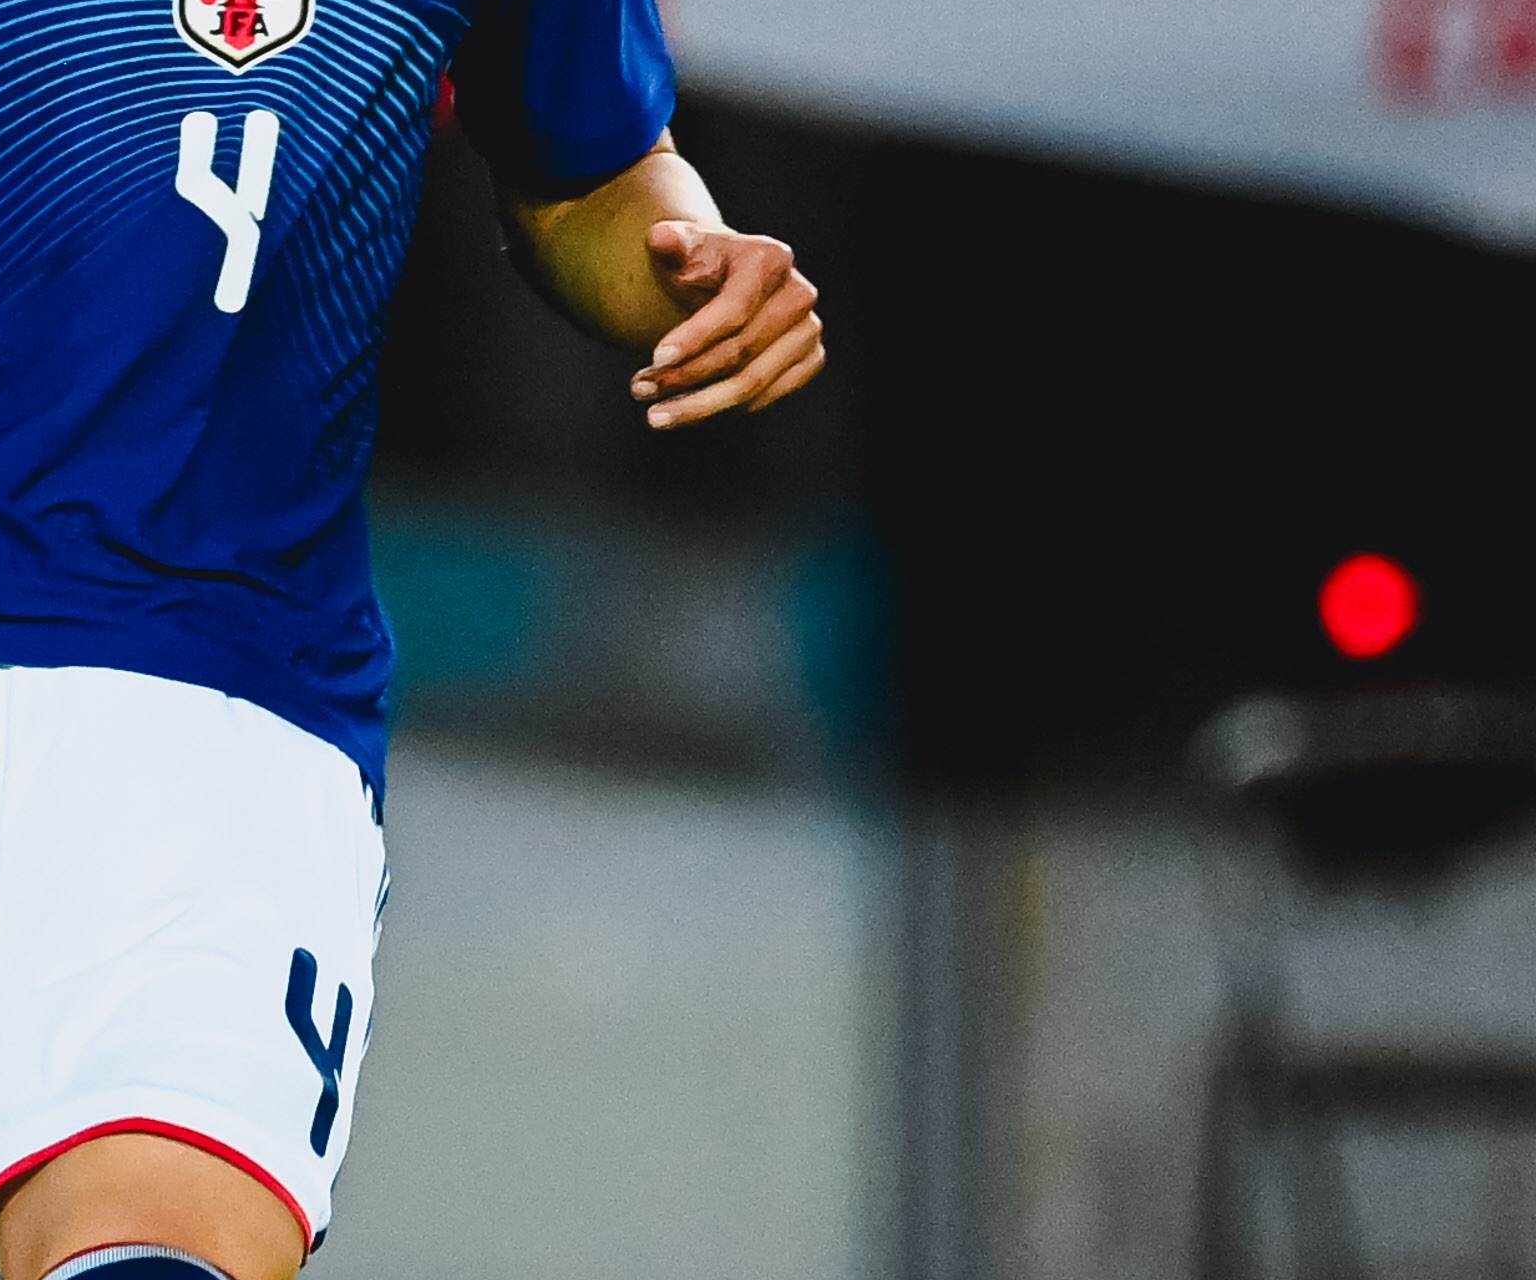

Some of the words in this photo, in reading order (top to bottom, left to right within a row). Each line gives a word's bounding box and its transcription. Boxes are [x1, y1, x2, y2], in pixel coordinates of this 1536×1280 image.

[209, 10, 269, 37] JFA
[175, 109, 280, 313] 4
[285, 947, 353, 1158] 4
